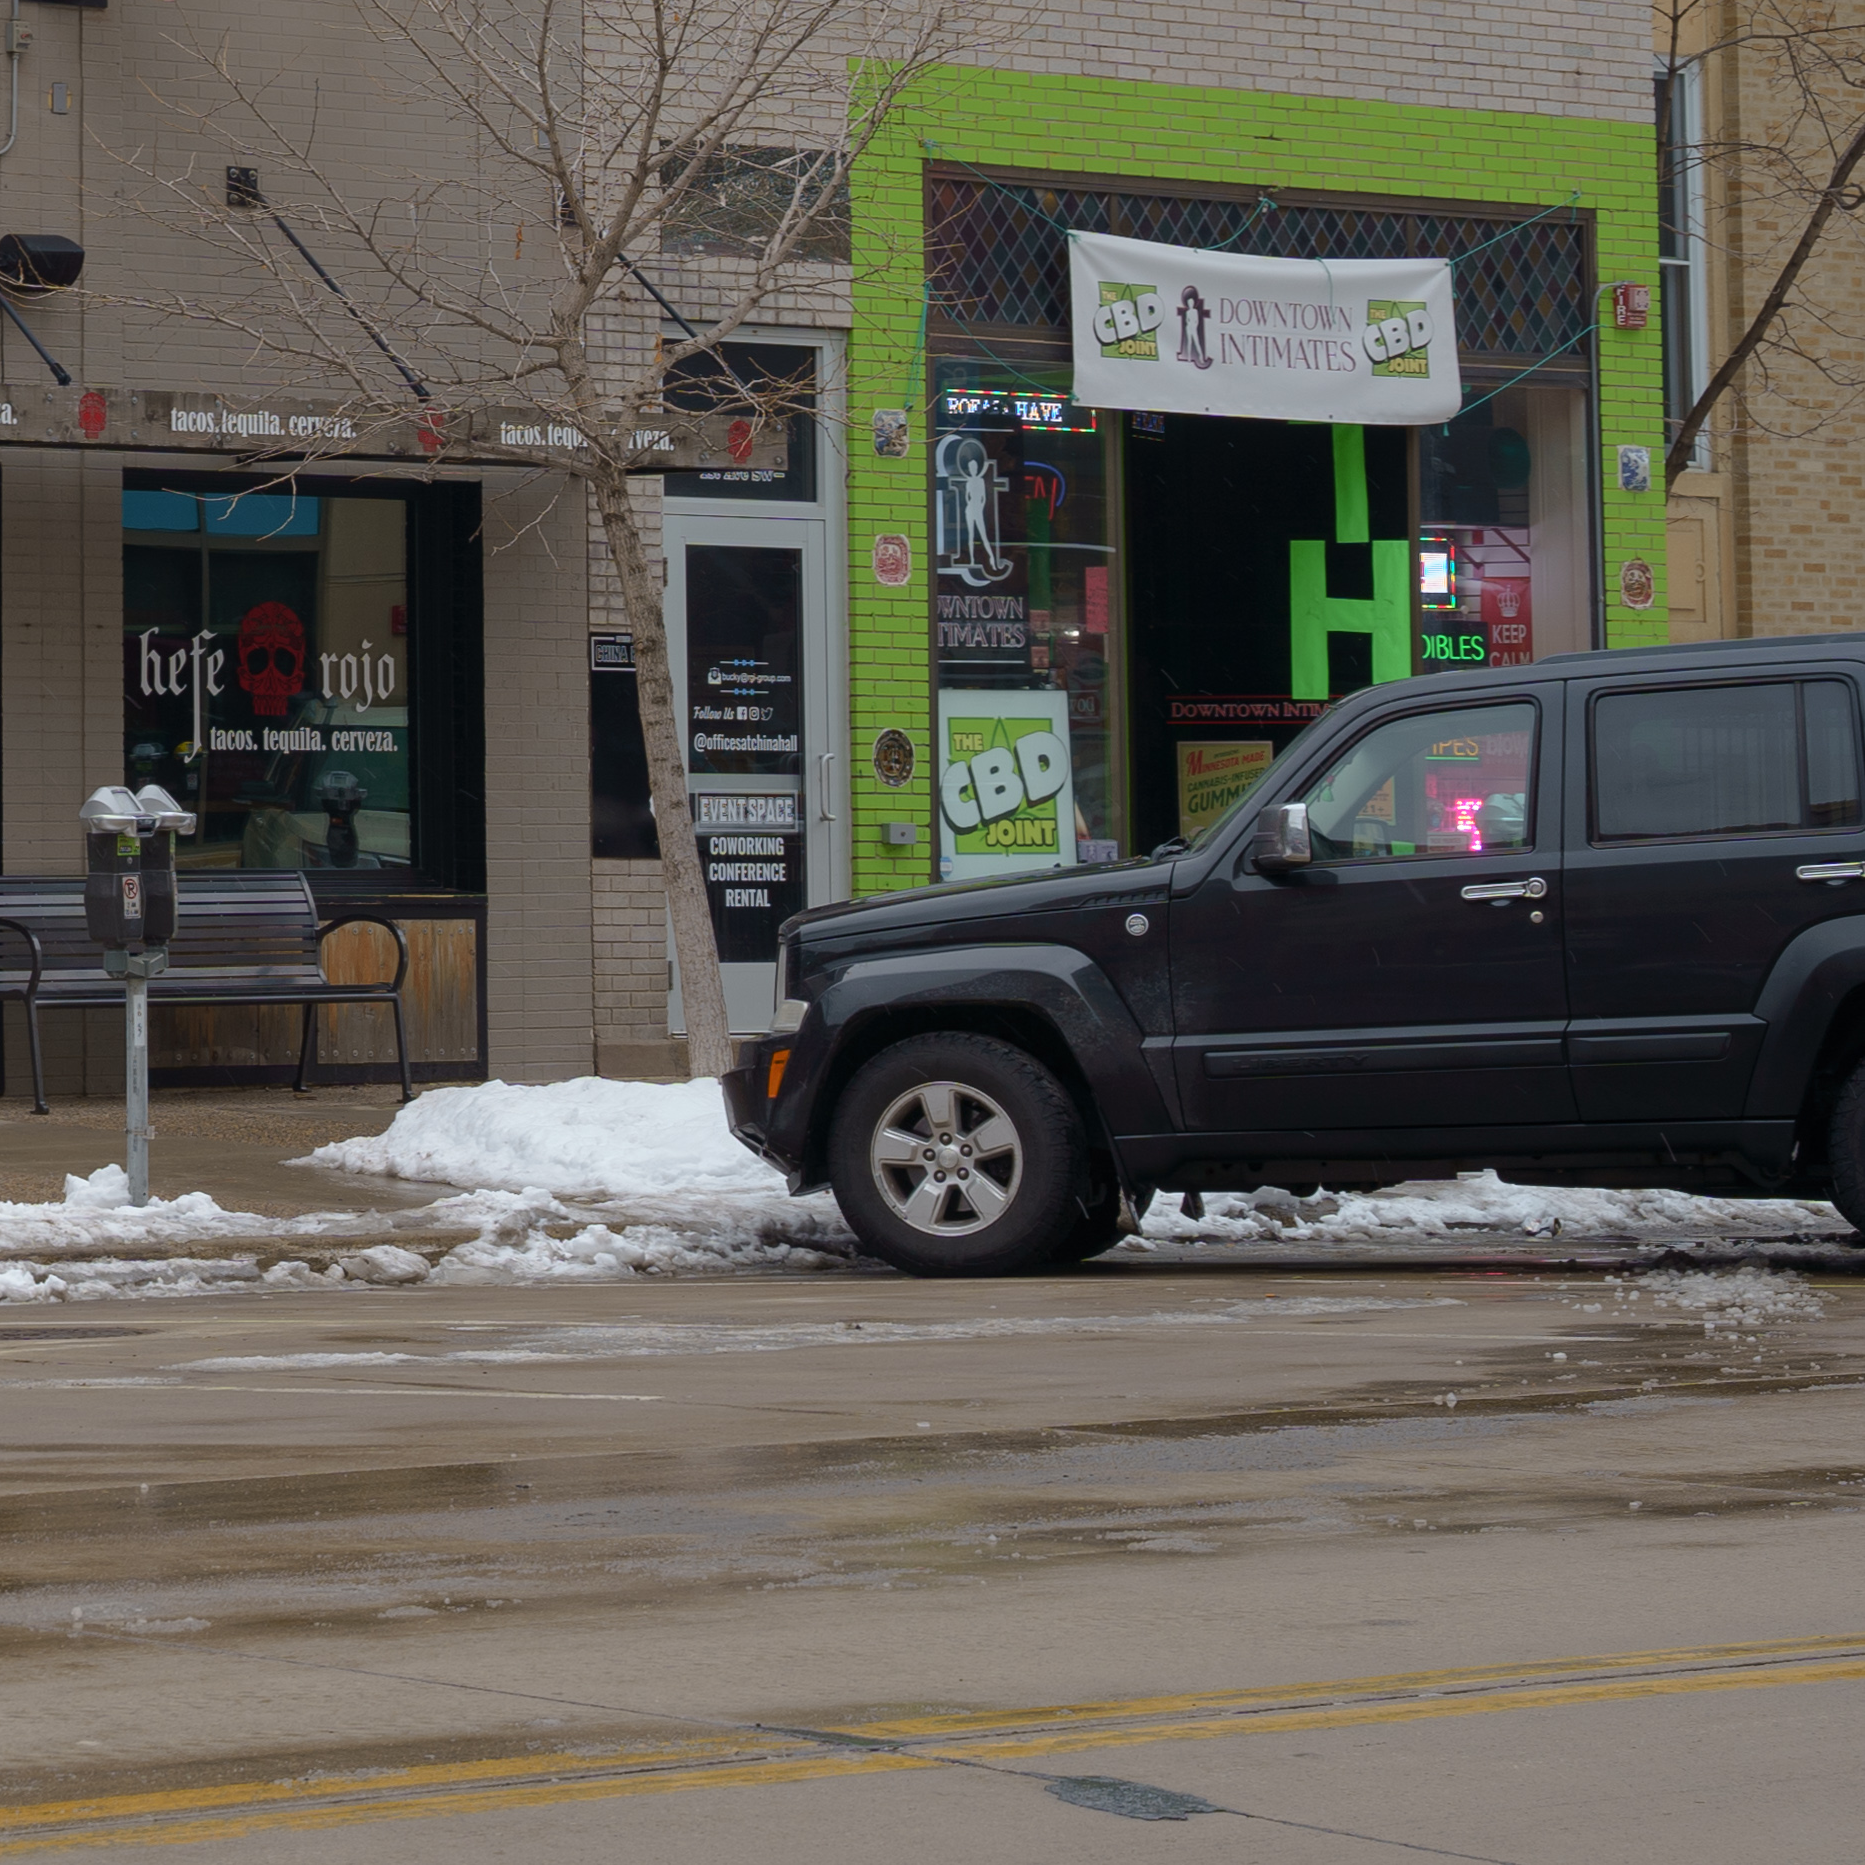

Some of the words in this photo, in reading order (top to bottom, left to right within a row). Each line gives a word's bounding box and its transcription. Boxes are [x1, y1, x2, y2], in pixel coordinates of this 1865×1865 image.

[1102, 290, 1118, 302] THE
[1616, 285, 1626, 325] FIRE
[1093, 292, 1165, 346] CBD
[1219, 297, 1353, 333] DOWNTOWN
[1370, 308, 1386, 320] THE
[1119, 338, 1158, 358] JOINT
[1362, 309, 1434, 364] CBD
[1220, 332, 1357, 373] INTIMATES
[1388, 357, 1428, 376] JOINT
[171, 407, 219, 434] tacos.
[222, 409, 285, 437] tequila.
[289, 415, 357, 438] cerveza.
[1014, 400, 1063, 422] HAVE
[500, 420, 546, 446] tacos.
[937, 594, 1024, 620] WNTOWN
[937, 622, 1026, 648] TIMATES
[1492, 624, 1527, 644] KEEP
[1489, 651, 1531, 668] CALM
[139, 627, 225, 764] hefe
[319, 639, 396, 713] rojo
[693, 706, 722, 719] Follow
[723, 707, 735, 719] Us
[1171, 702, 1280, 718] DOWNTOWN
[1283, 701, 1331, 717] INTIM
[210, 726, 258, 751] tacos.
[262, 726, 326, 755] tequila.
[331, 729, 398, 752] cerveza.
[694, 733, 797, 752] @officesatchinahall
[952, 732, 984, 751] THE
[1186, 749, 1239, 777] MINNESOTA
[1242, 750, 1265, 764] MADE
[941, 731, 1069, 835] CBD
[700, 796, 747, 823] EVENT
[748, 797, 794, 824] SPACE
[986, 818, 1056, 847] JOINT
[710, 837, 784, 855] COWORKING
[709, 862, 787, 881] CONFERENCE
[725, 889, 771, 907] RENTAL
